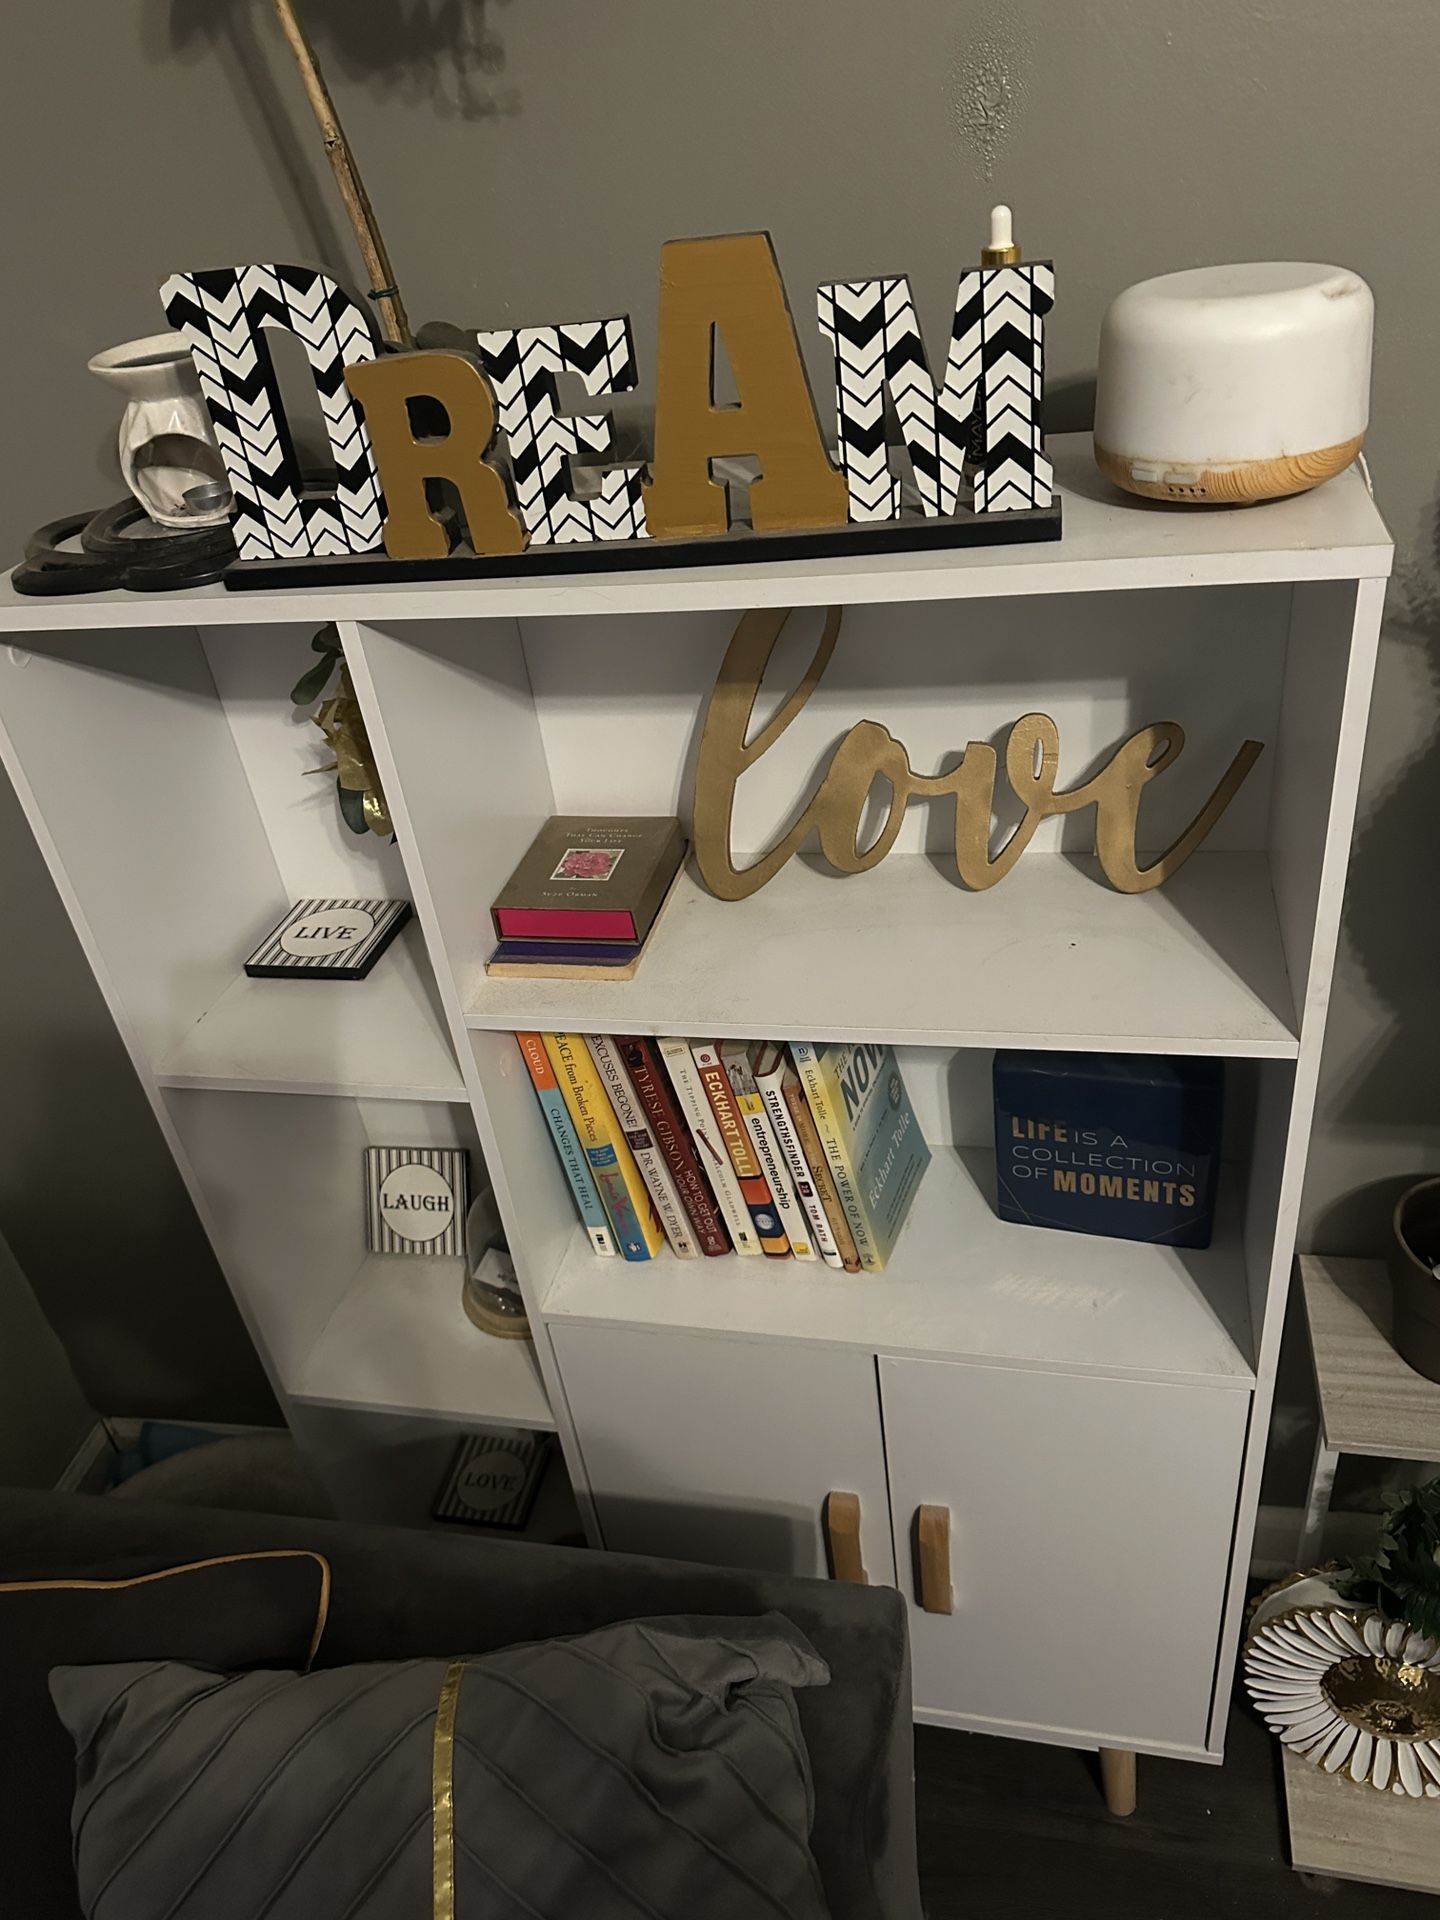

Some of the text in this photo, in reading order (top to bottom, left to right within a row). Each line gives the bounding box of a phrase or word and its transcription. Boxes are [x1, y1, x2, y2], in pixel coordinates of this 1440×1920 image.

[159, 230, 1056, 563] DREAM
[693, 605, 1265, 901] love
[294, 925, 357, 940] LIVE
[525, 1039, 545, 1074] CLOUD
[554, 1031, 598, 1142] EACE from Broken Pieces
[591, 1034, 638, 1128] EXCUSES BEGONE!
[804, 1068, 827, 1120] Eckhart Tolle
[634, 1066, 666, 1119] TYRESE
[656, 1120, 685, 1170] GIBSON
[705, 1071, 740, 1138] ECKHART
[765, 1090, 806, 1178] STRENGTHSFINDER
[826, 1137, 842, 1161] THE
[1012, 1116, 1129, 1149] LIFE IS A
[550, 1108, 593, 1211] CHANGES THAT HEAL
[751, 1117, 791, 1210] entrepreneurship
[868, 1147, 896, 1210] Eckhart
[891, 1111, 910, 1148] Tolle
[1012, 1145, 1196, 1177] COLLECTION
[640, 1152, 653, 1169] DR.
[648, 1168, 669, 1202] WAYNE
[666, 1215, 684, 1239] DYER
[674, 1173, 691, 1196] YOUR
[682, 1169, 700, 1190] HOW
[693, 1188, 705, 1202] TO
[834, 1164, 855, 1203] POWER
[1012, 1164, 1196, 1208] OF MOMENTS
[383, 1192, 450, 1213] LAUGH
[697, 1202, 711, 1217] GET
[847, 1204, 860, 1220] OF
[703, 1216, 717, 1233] OUT
[808, 1204, 829, 1242] TOM RATH
[853, 1221, 869, 1246] NOW
[465, 1472, 518, 1490] LOVE
